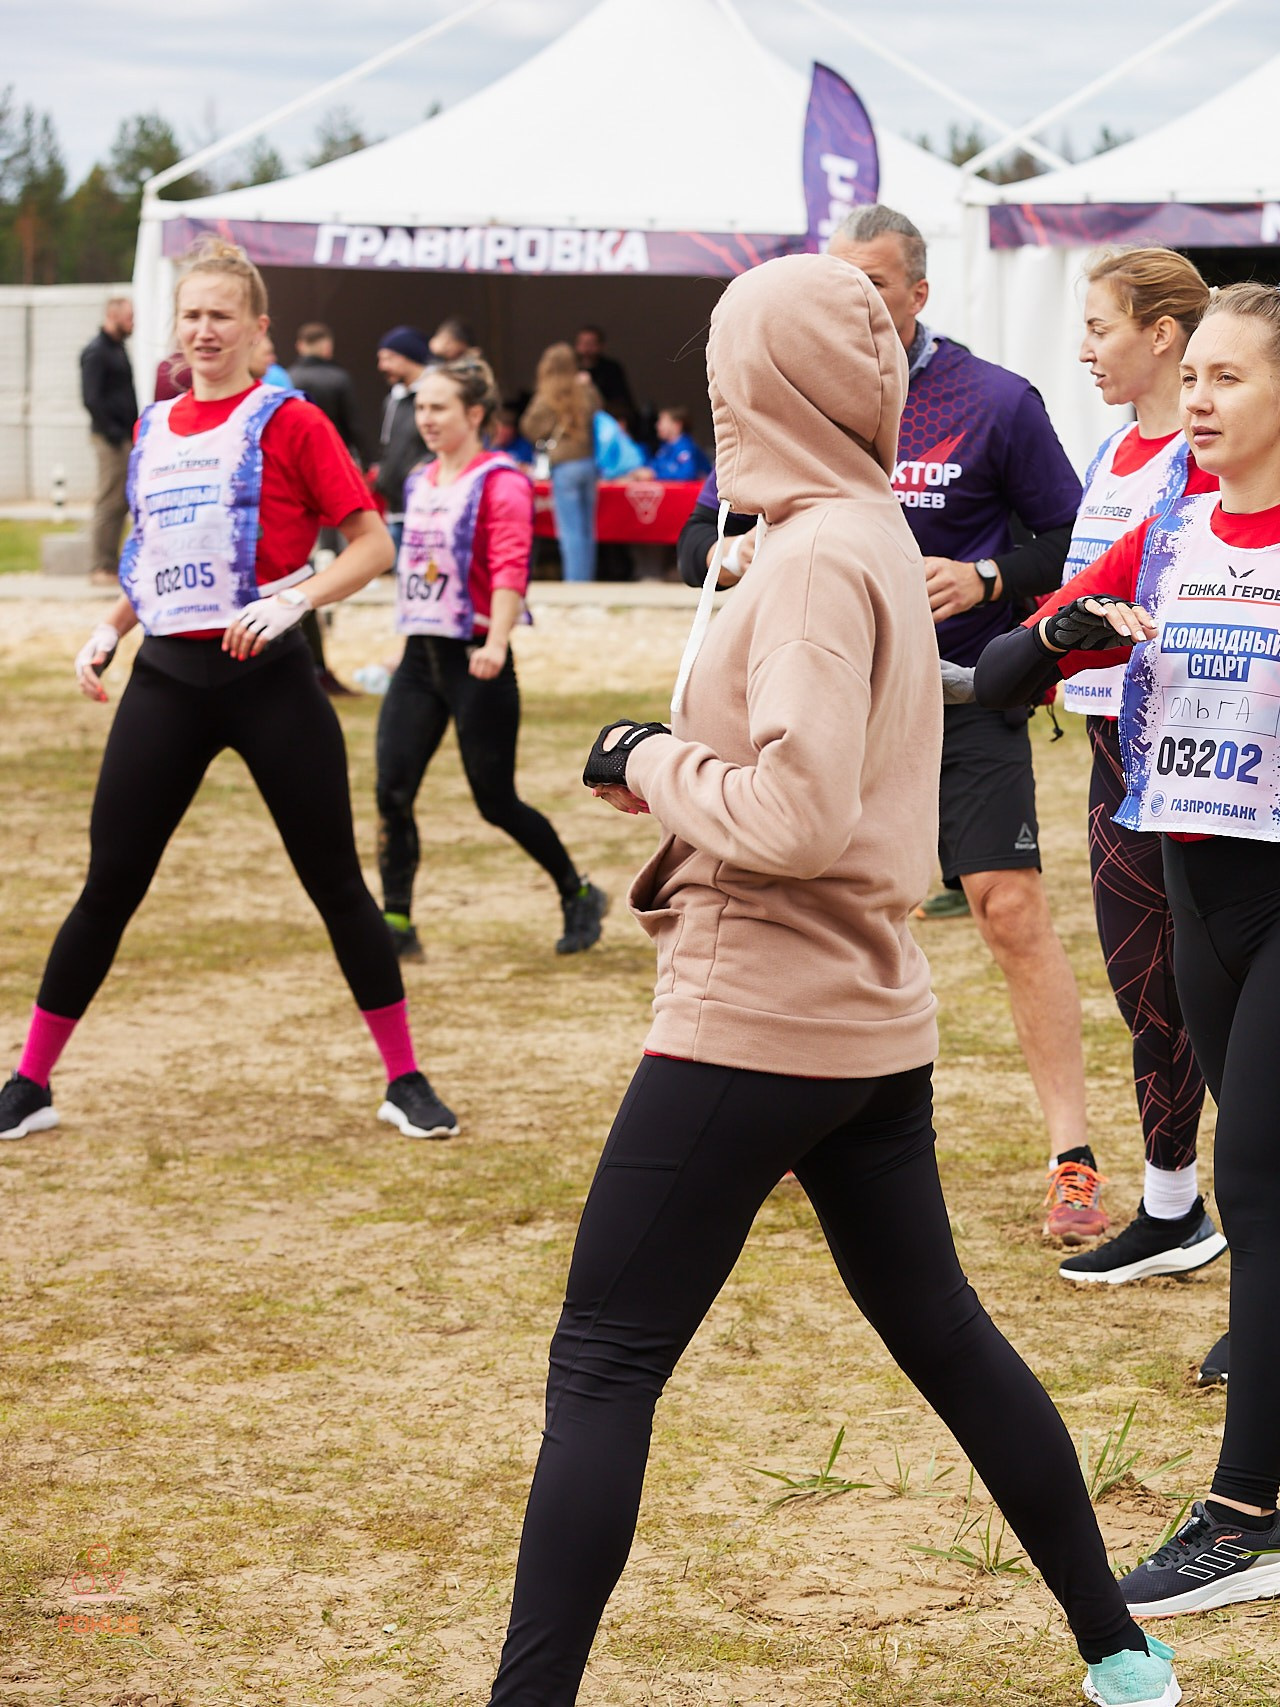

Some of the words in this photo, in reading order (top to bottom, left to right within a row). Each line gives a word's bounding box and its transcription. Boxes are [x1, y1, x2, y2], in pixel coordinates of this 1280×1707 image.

[313, 224, 651, 272] ГРАВИРОВКА
[1179, 583, 1227, 596] ГОНКА
[1191, 655, 1248, 678] СТАРТ
[1169, 696, 1254, 723] ОЛЬГА
[1156, 736, 1262, 784] 03202
[1170, 798, 1257, 821] ГАЗПРОМБАНК
